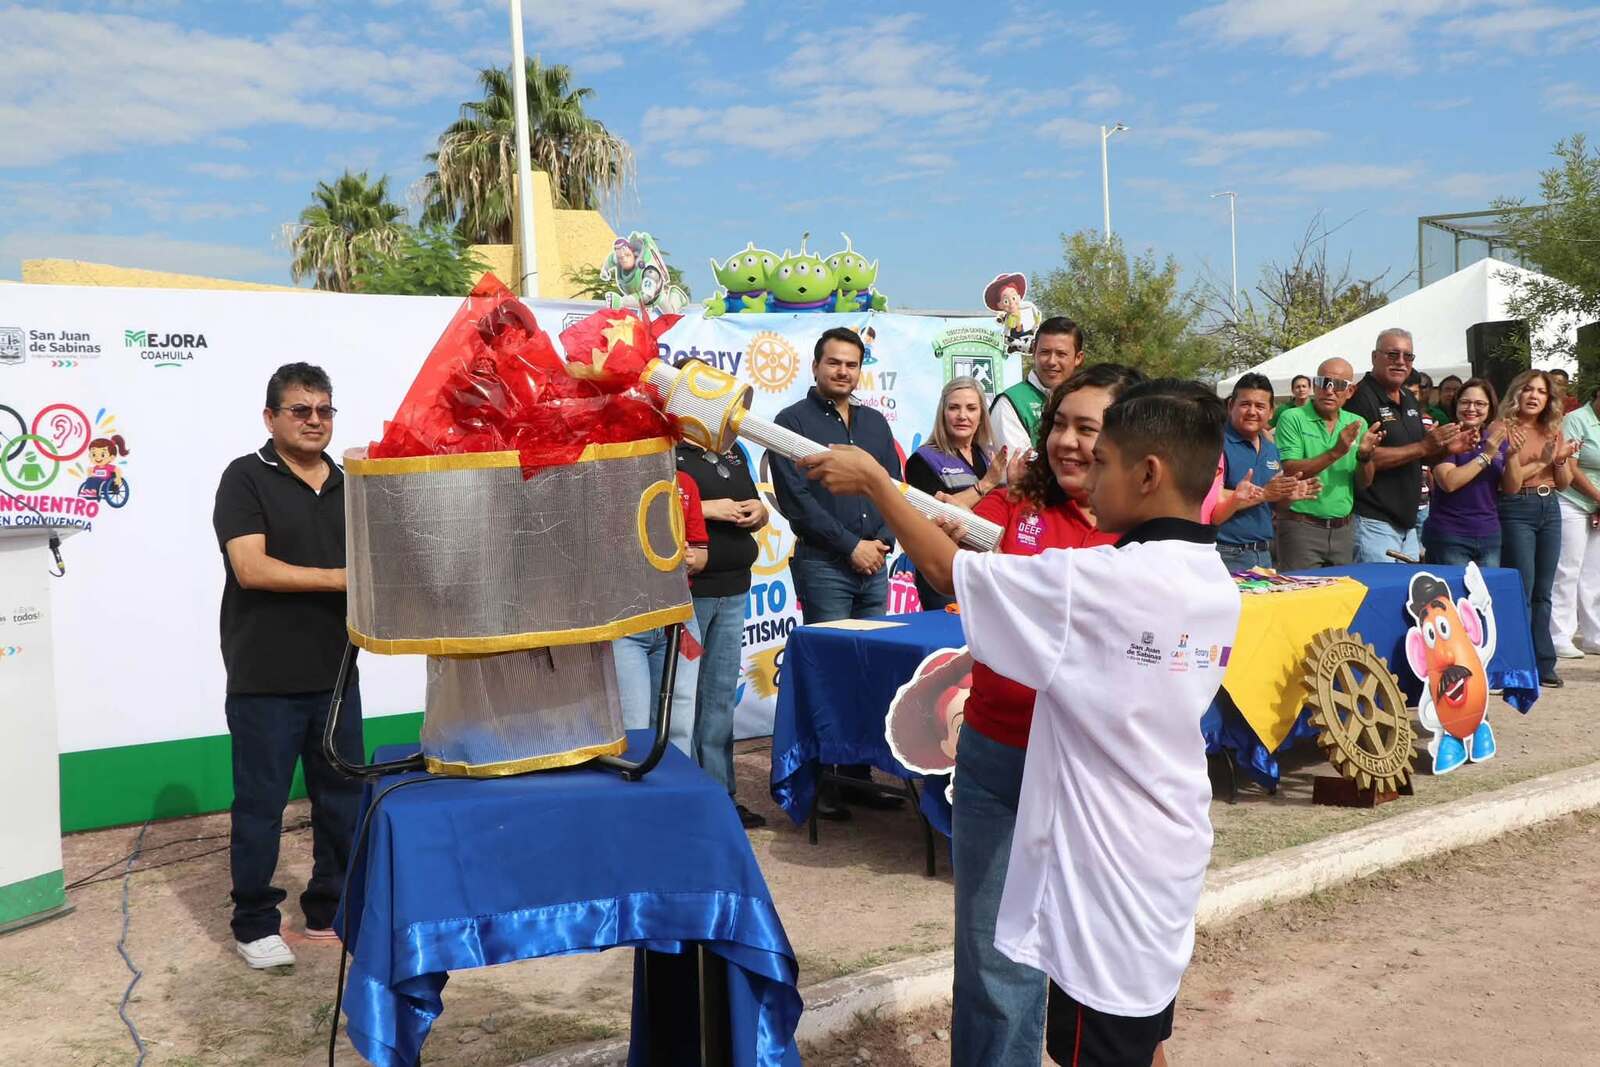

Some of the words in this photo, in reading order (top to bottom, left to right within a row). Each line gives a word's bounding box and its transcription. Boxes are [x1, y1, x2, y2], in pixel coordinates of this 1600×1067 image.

[29, 330, 56, 341] San
[59, 330, 91, 342] Juan
[125, 330, 208, 348] MEJORA
[29, 342, 47, 353] de
[49, 342, 101, 353] Sabinas
[141, 351, 194, 360] COAHUILA
[656, 343, 742, 376] Rotary
[878, 371, 898, 391] 17
[0, 494, 99, 518] NCUENTRO
[1322, 643, 1366, 675] ROTARY
[1345, 721, 1408, 773] INTERNATIONAL
